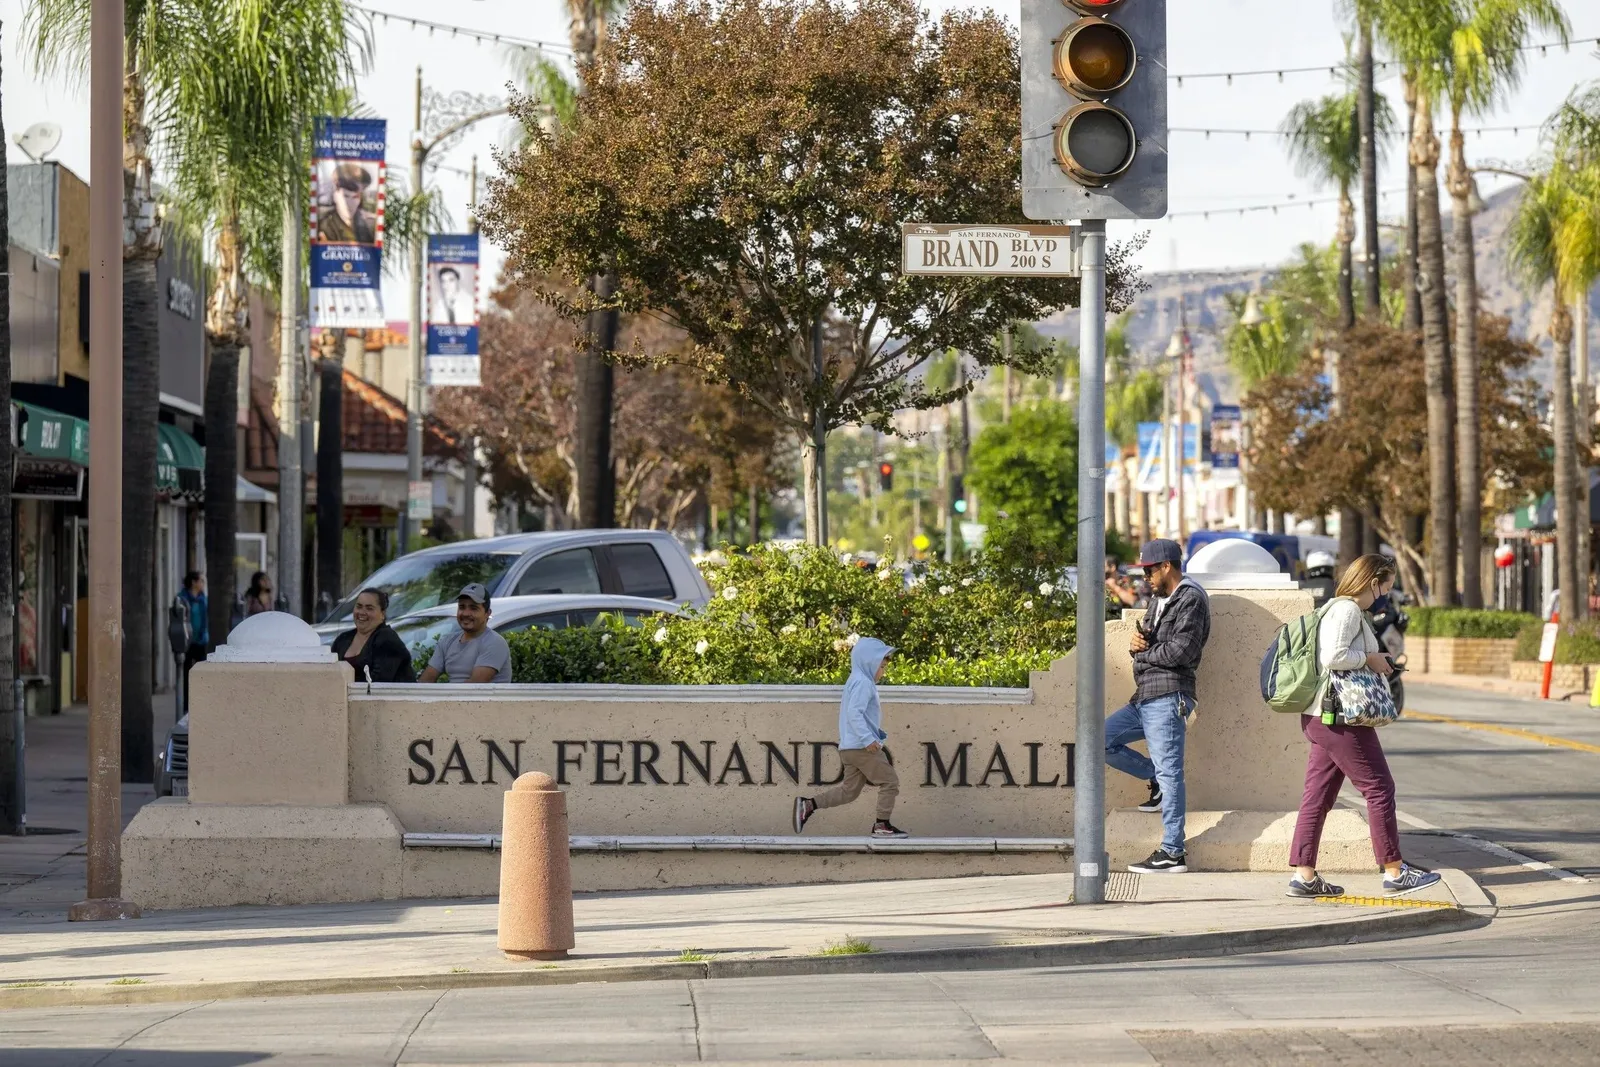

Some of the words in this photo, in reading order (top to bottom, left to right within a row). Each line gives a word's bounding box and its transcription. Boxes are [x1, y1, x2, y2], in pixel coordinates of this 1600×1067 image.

[332, 139, 385, 152] FERNANDO
[976, 231, 1021, 239] FERNANDO
[921, 239, 999, 268] BRAND
[1011, 239, 1058, 253] BLVD
[1010, 255, 1036, 268] 200
[1041, 255, 1052, 268] S
[407, 738, 526, 786] SAN
[552, 739, 895, 787] FERNAND
